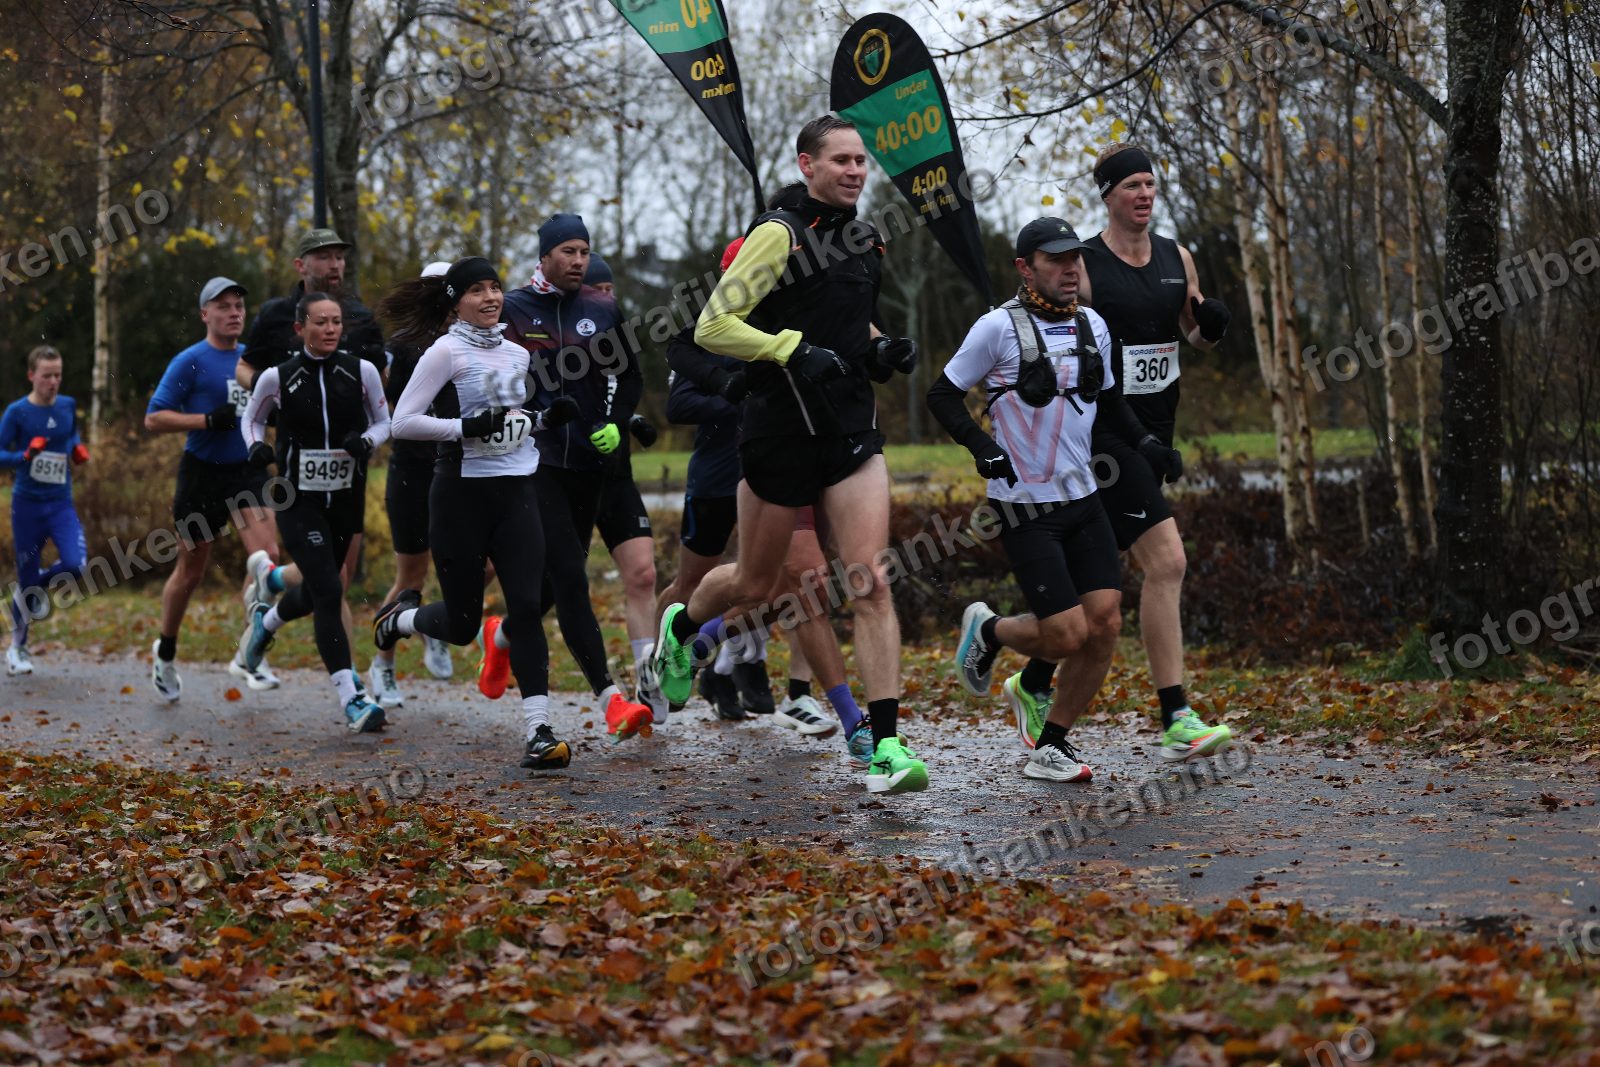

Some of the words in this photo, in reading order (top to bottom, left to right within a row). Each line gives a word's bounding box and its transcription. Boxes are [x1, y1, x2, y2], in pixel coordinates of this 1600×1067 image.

[895, 79, 928, 100] Under
[875, 105, 941, 155] 40:00
[911, 165, 948, 197] 4:00
[1135, 356, 1169, 383] 360
[231, 389, 249, 408] 95
[34, 458, 65, 476] 9514
[304, 459, 351, 481] 9495
